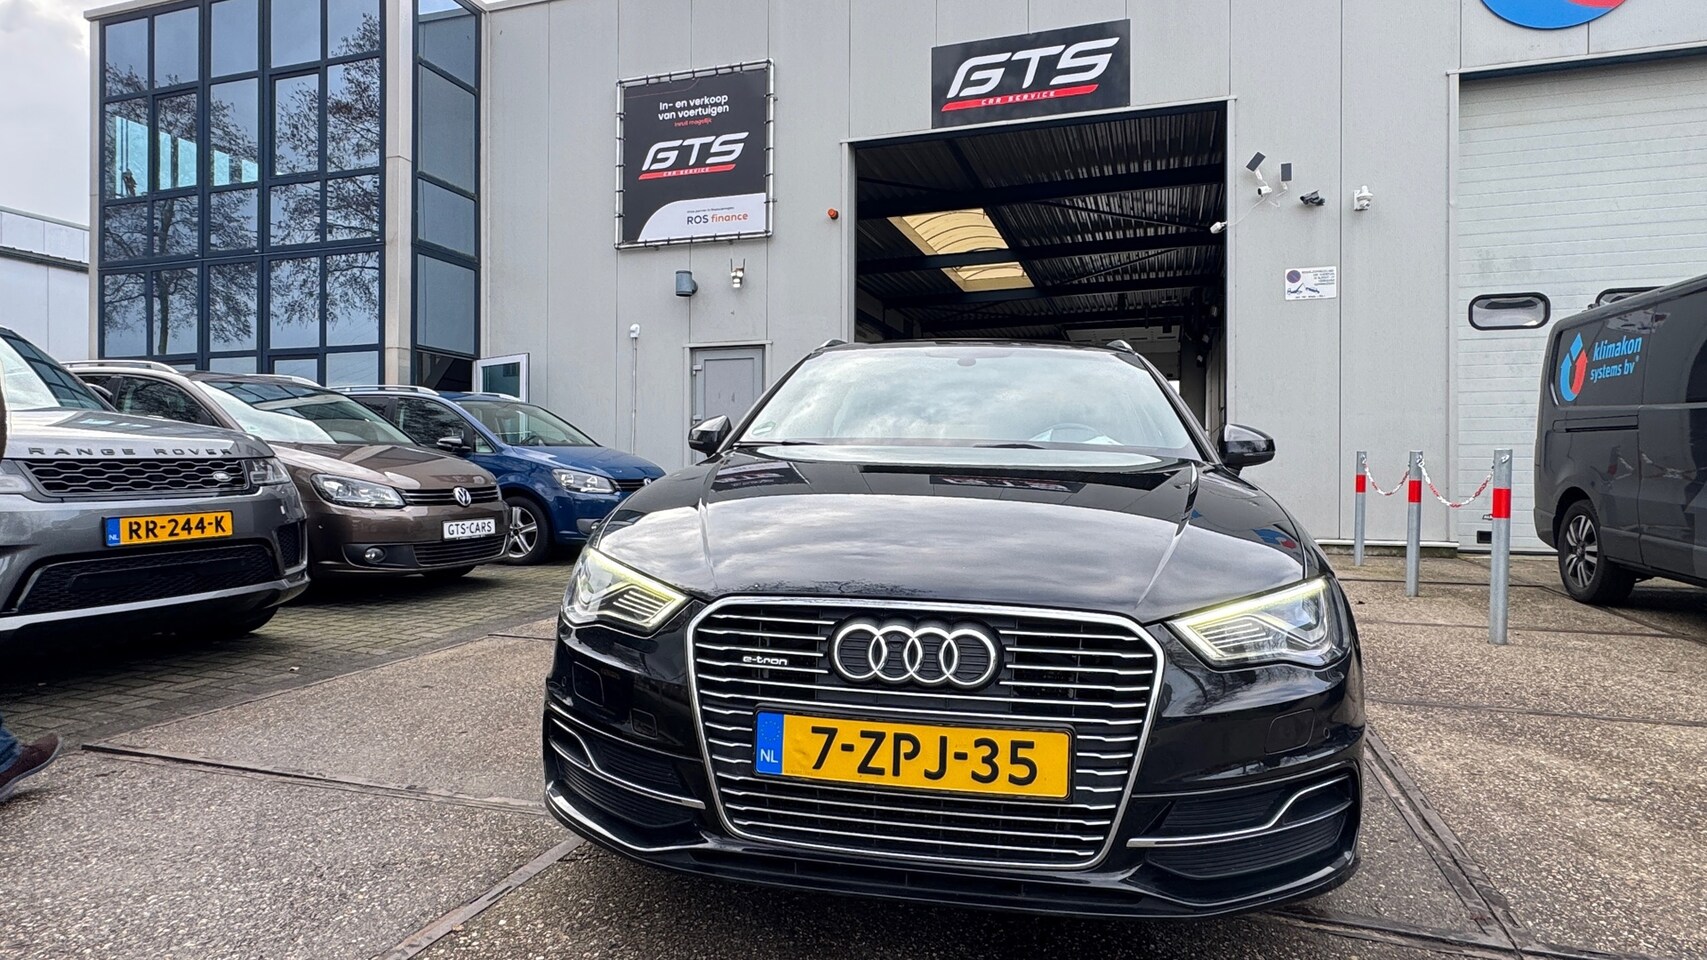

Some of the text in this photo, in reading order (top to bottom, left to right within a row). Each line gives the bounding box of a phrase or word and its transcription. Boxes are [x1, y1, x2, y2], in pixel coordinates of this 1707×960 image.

[947, 37, 1120, 99] GTS
[659, 95, 728, 110] In- en verkoop
[981, 91, 1056, 106] CAR SERVICE
[658, 105, 729, 121] van voertuigen
[641, 131, 749, 171] GTS
[686, 213, 749, 225] ROS finance
[1593, 336, 1642, 361] klimakon
[1590, 365, 1622, 383] systems
[28, 446, 233, 456] RANGE ROVER
[128, 515, 226, 540] RR-244-K
[447, 521, 492, 535] GTS-CARS
[742, 655, 788, 666] e-tron
[760, 748, 779, 764] NL
[810, 725, 1038, 787] 7-ZPJ-35
